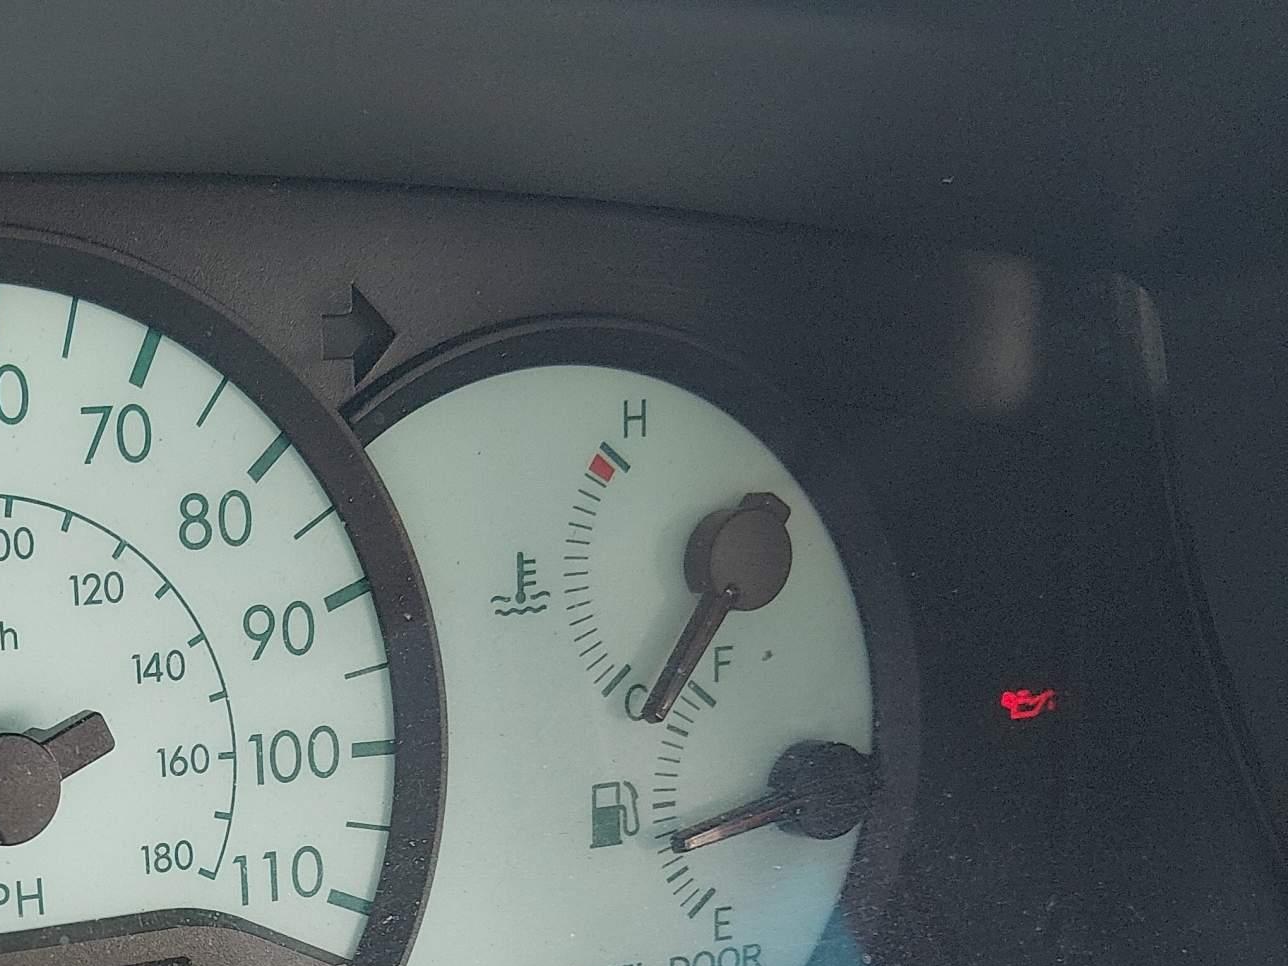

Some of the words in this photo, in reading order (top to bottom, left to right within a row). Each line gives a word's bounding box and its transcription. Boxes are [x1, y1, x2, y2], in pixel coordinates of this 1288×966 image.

[81, 404, 151, 464] 70
[624, 399, 646, 438] H
[179, 490, 251, 550] 80
[69, 572, 123, 606] 120
[243, 601, 314, 660] 90
[133, 650, 185, 684] 140
[714, 646, 733, 682] F
[157, 744, 209, 777] 160
[248, 726, 339, 785] 100
[141, 840, 193, 874] 180
[233, 846, 323, 906] 110
[715, 906, 732, 941] E
